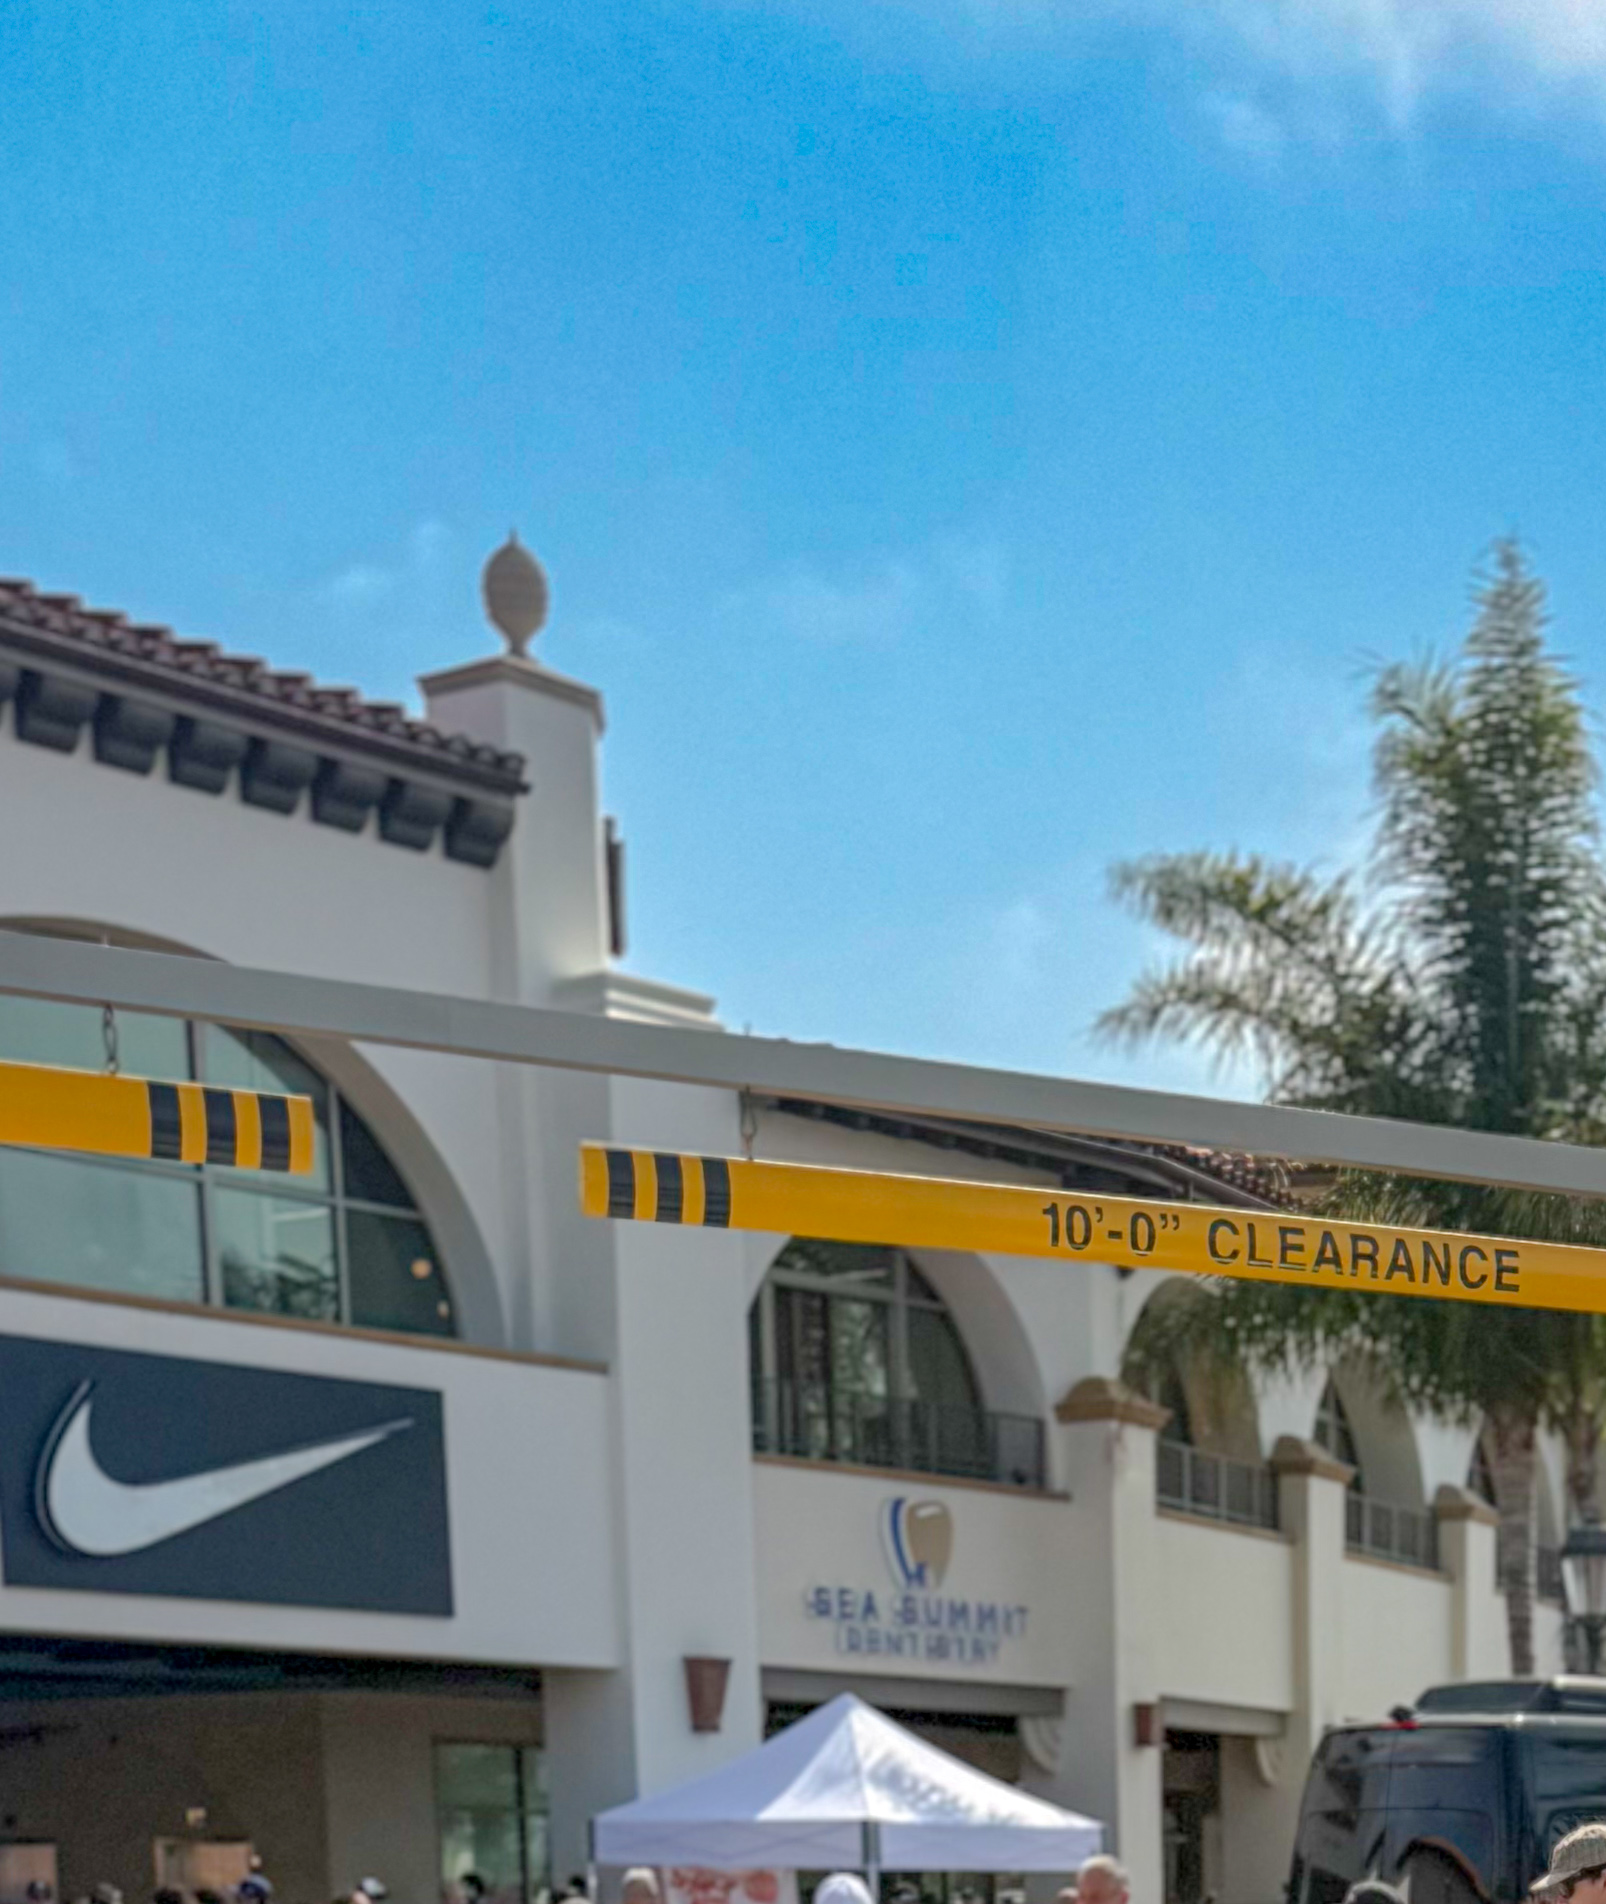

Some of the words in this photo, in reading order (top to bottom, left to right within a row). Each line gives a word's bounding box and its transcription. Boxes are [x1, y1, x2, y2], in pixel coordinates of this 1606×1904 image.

[1207, 1217, 1521, 1293] CLEARANCE
[808, 1586, 880, 1623] SEA
[898, 1595, 1029, 1640] SUMMIT
